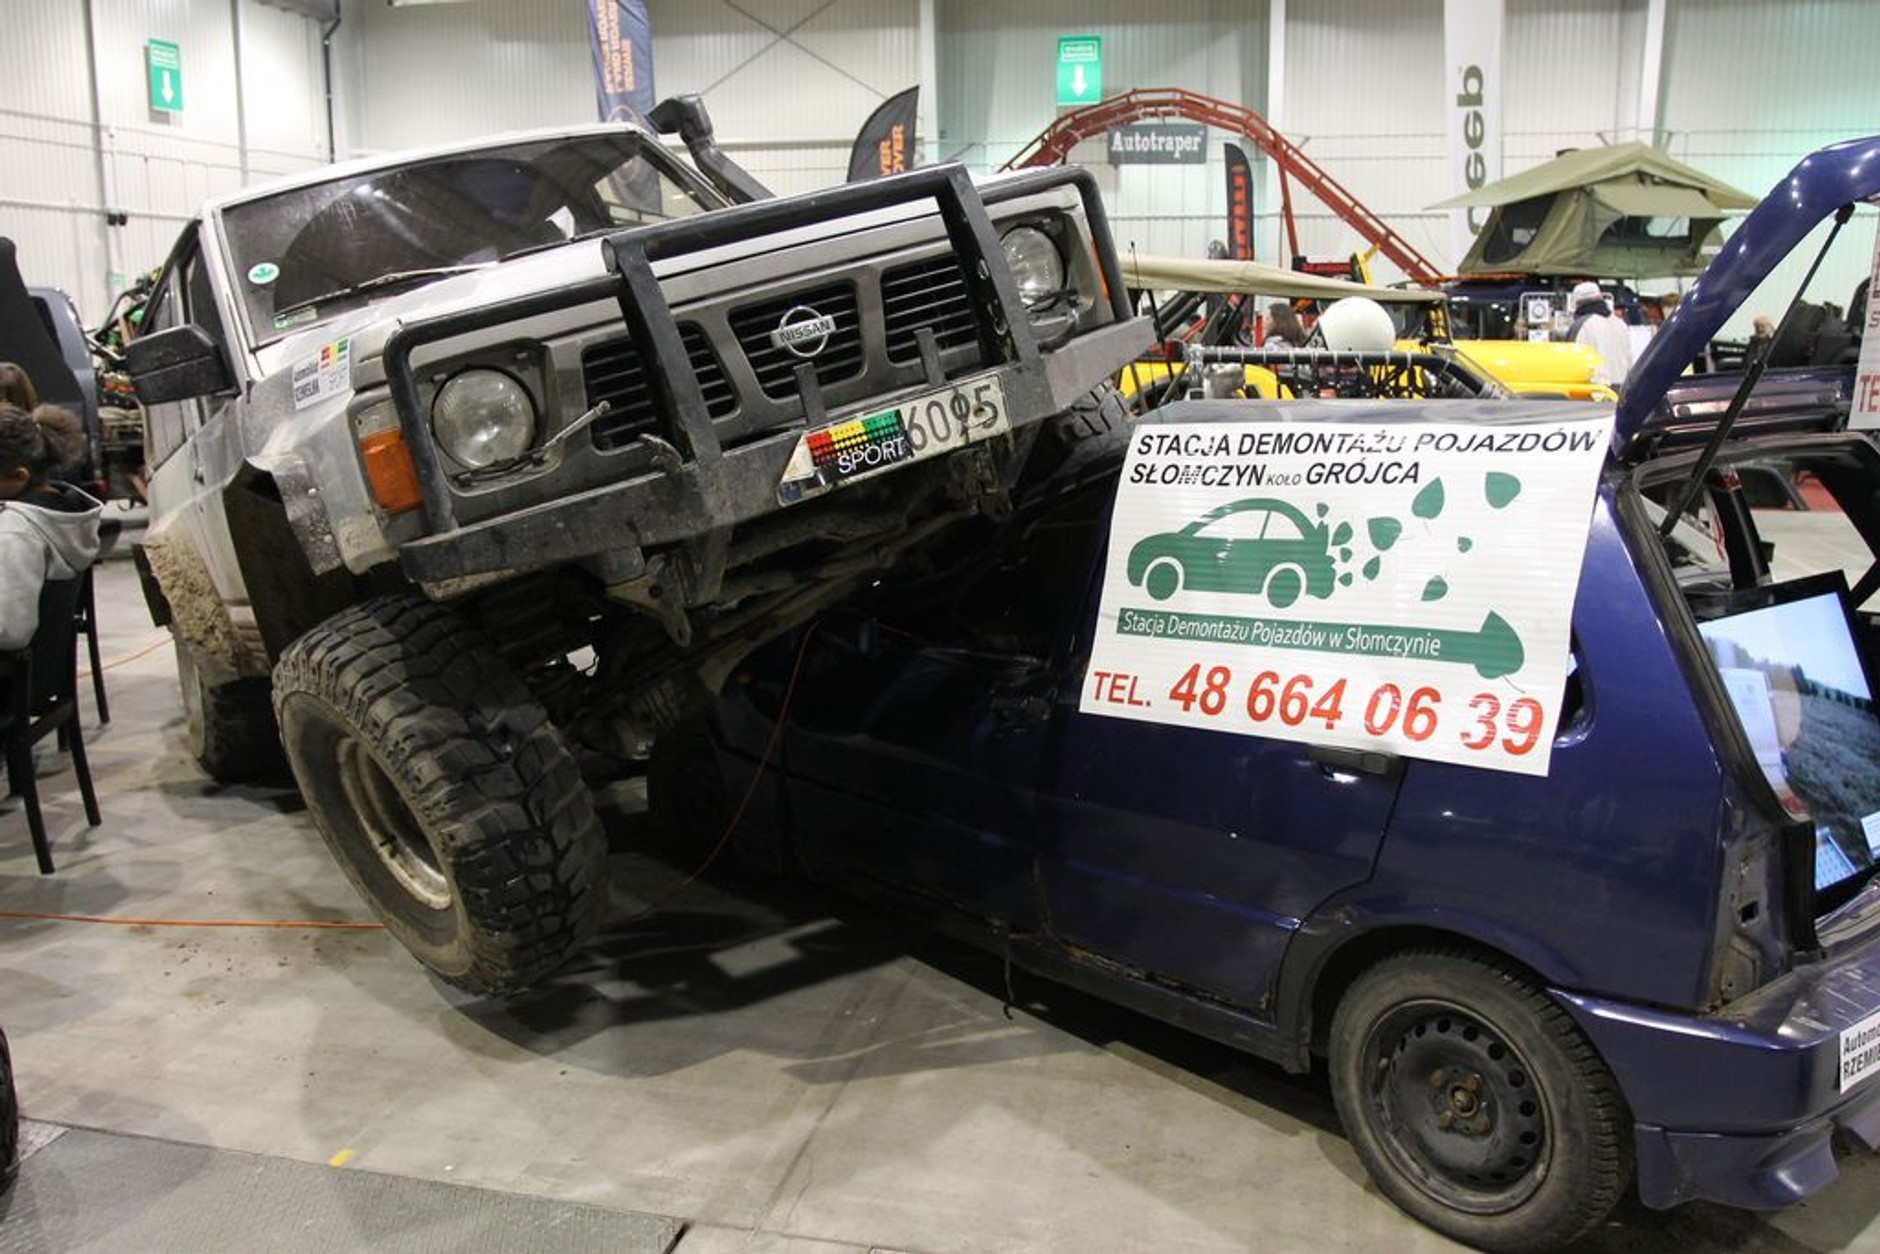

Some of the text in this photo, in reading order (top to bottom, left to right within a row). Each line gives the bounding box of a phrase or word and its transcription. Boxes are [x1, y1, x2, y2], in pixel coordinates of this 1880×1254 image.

[1111, 130, 1202, 159] Autotraper
[778, 319, 832, 343] NISSAN
[837, 436, 906, 475] SPORT
[1138, 427, 1603, 457] STACJA DEMONTAŻU POJAZDÓW
[1129, 457, 1421, 486] SŁOMCZYN KOŁO GRÓJCA
[1122, 611, 1442, 659] Stacja Demontażu Pojazdów w Słomczynie
[1093, 662, 1544, 756] TEL. 48 664 06 39
